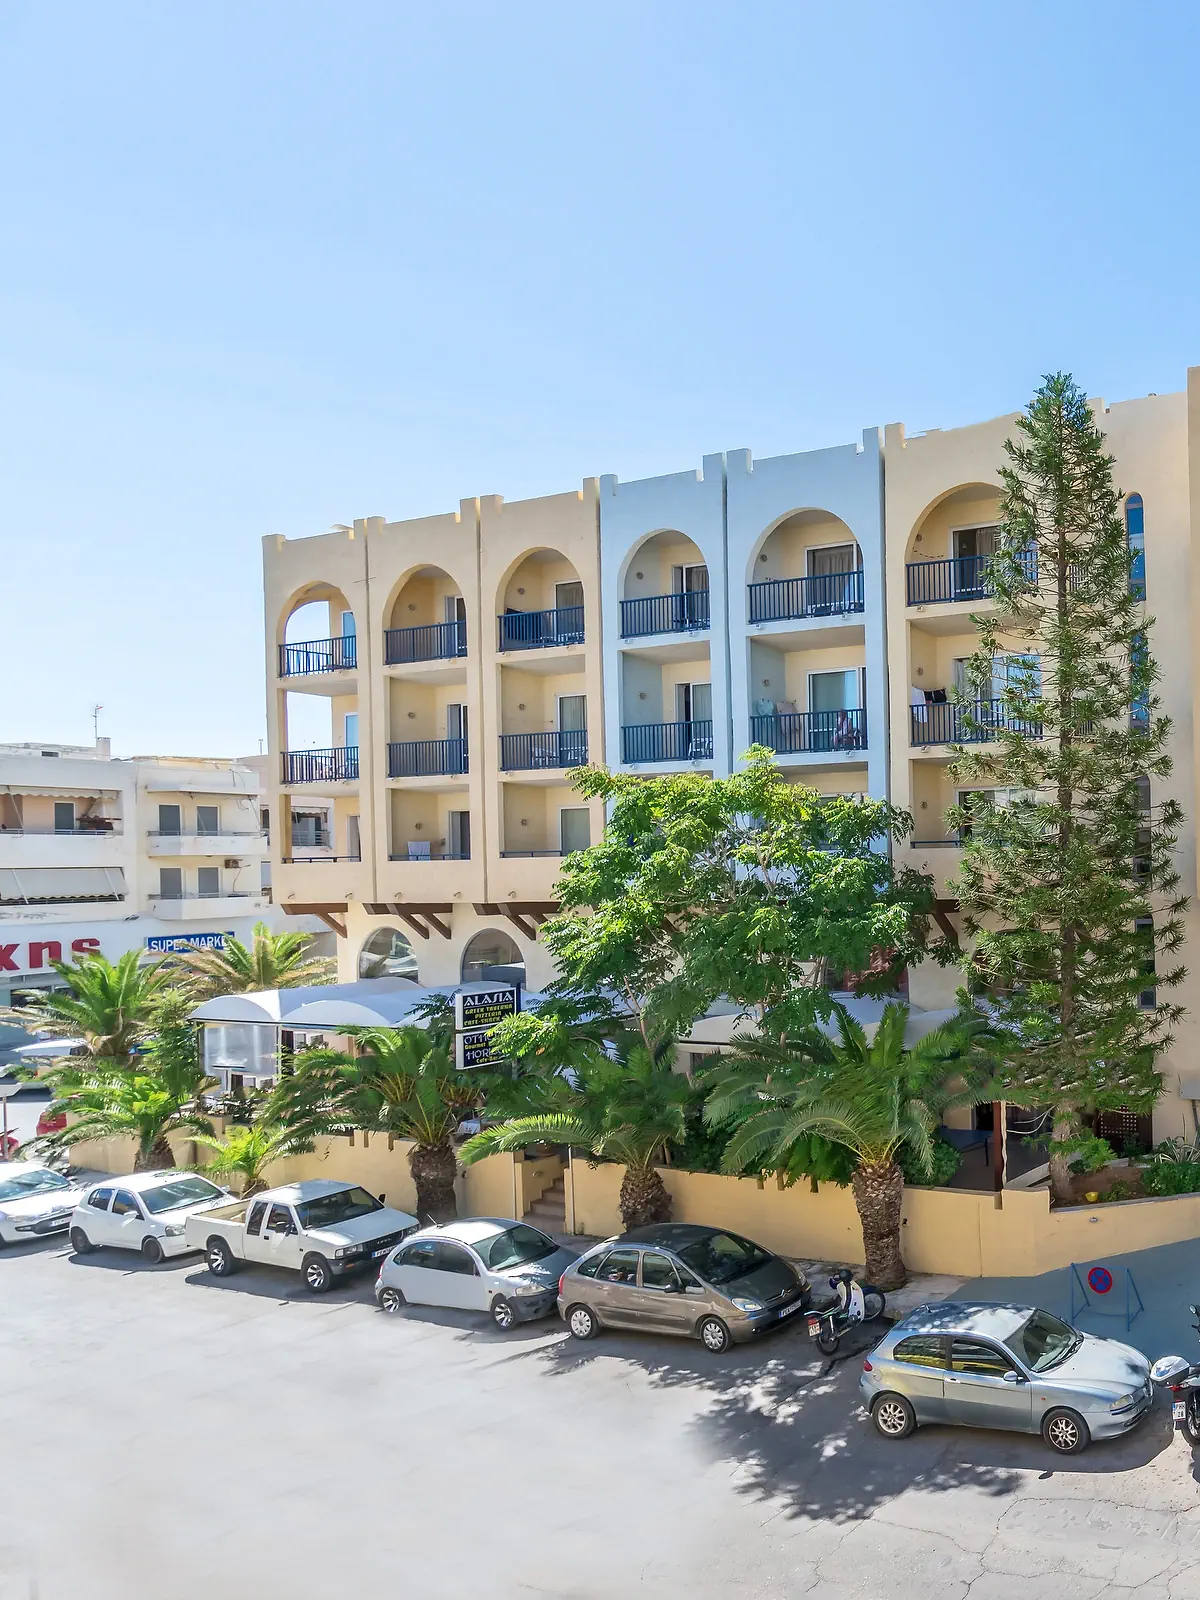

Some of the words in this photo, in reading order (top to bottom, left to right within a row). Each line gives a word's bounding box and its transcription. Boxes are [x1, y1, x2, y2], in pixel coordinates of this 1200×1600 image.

[190, 935, 229, 950] MARKE
[464, 991, 513, 1007] ALASIA
[465, 1007, 485, 1015] GREEK
[486, 1003, 513, 1012] TAVERNA
[475, 1010, 502, 1019] PIZZERIA
